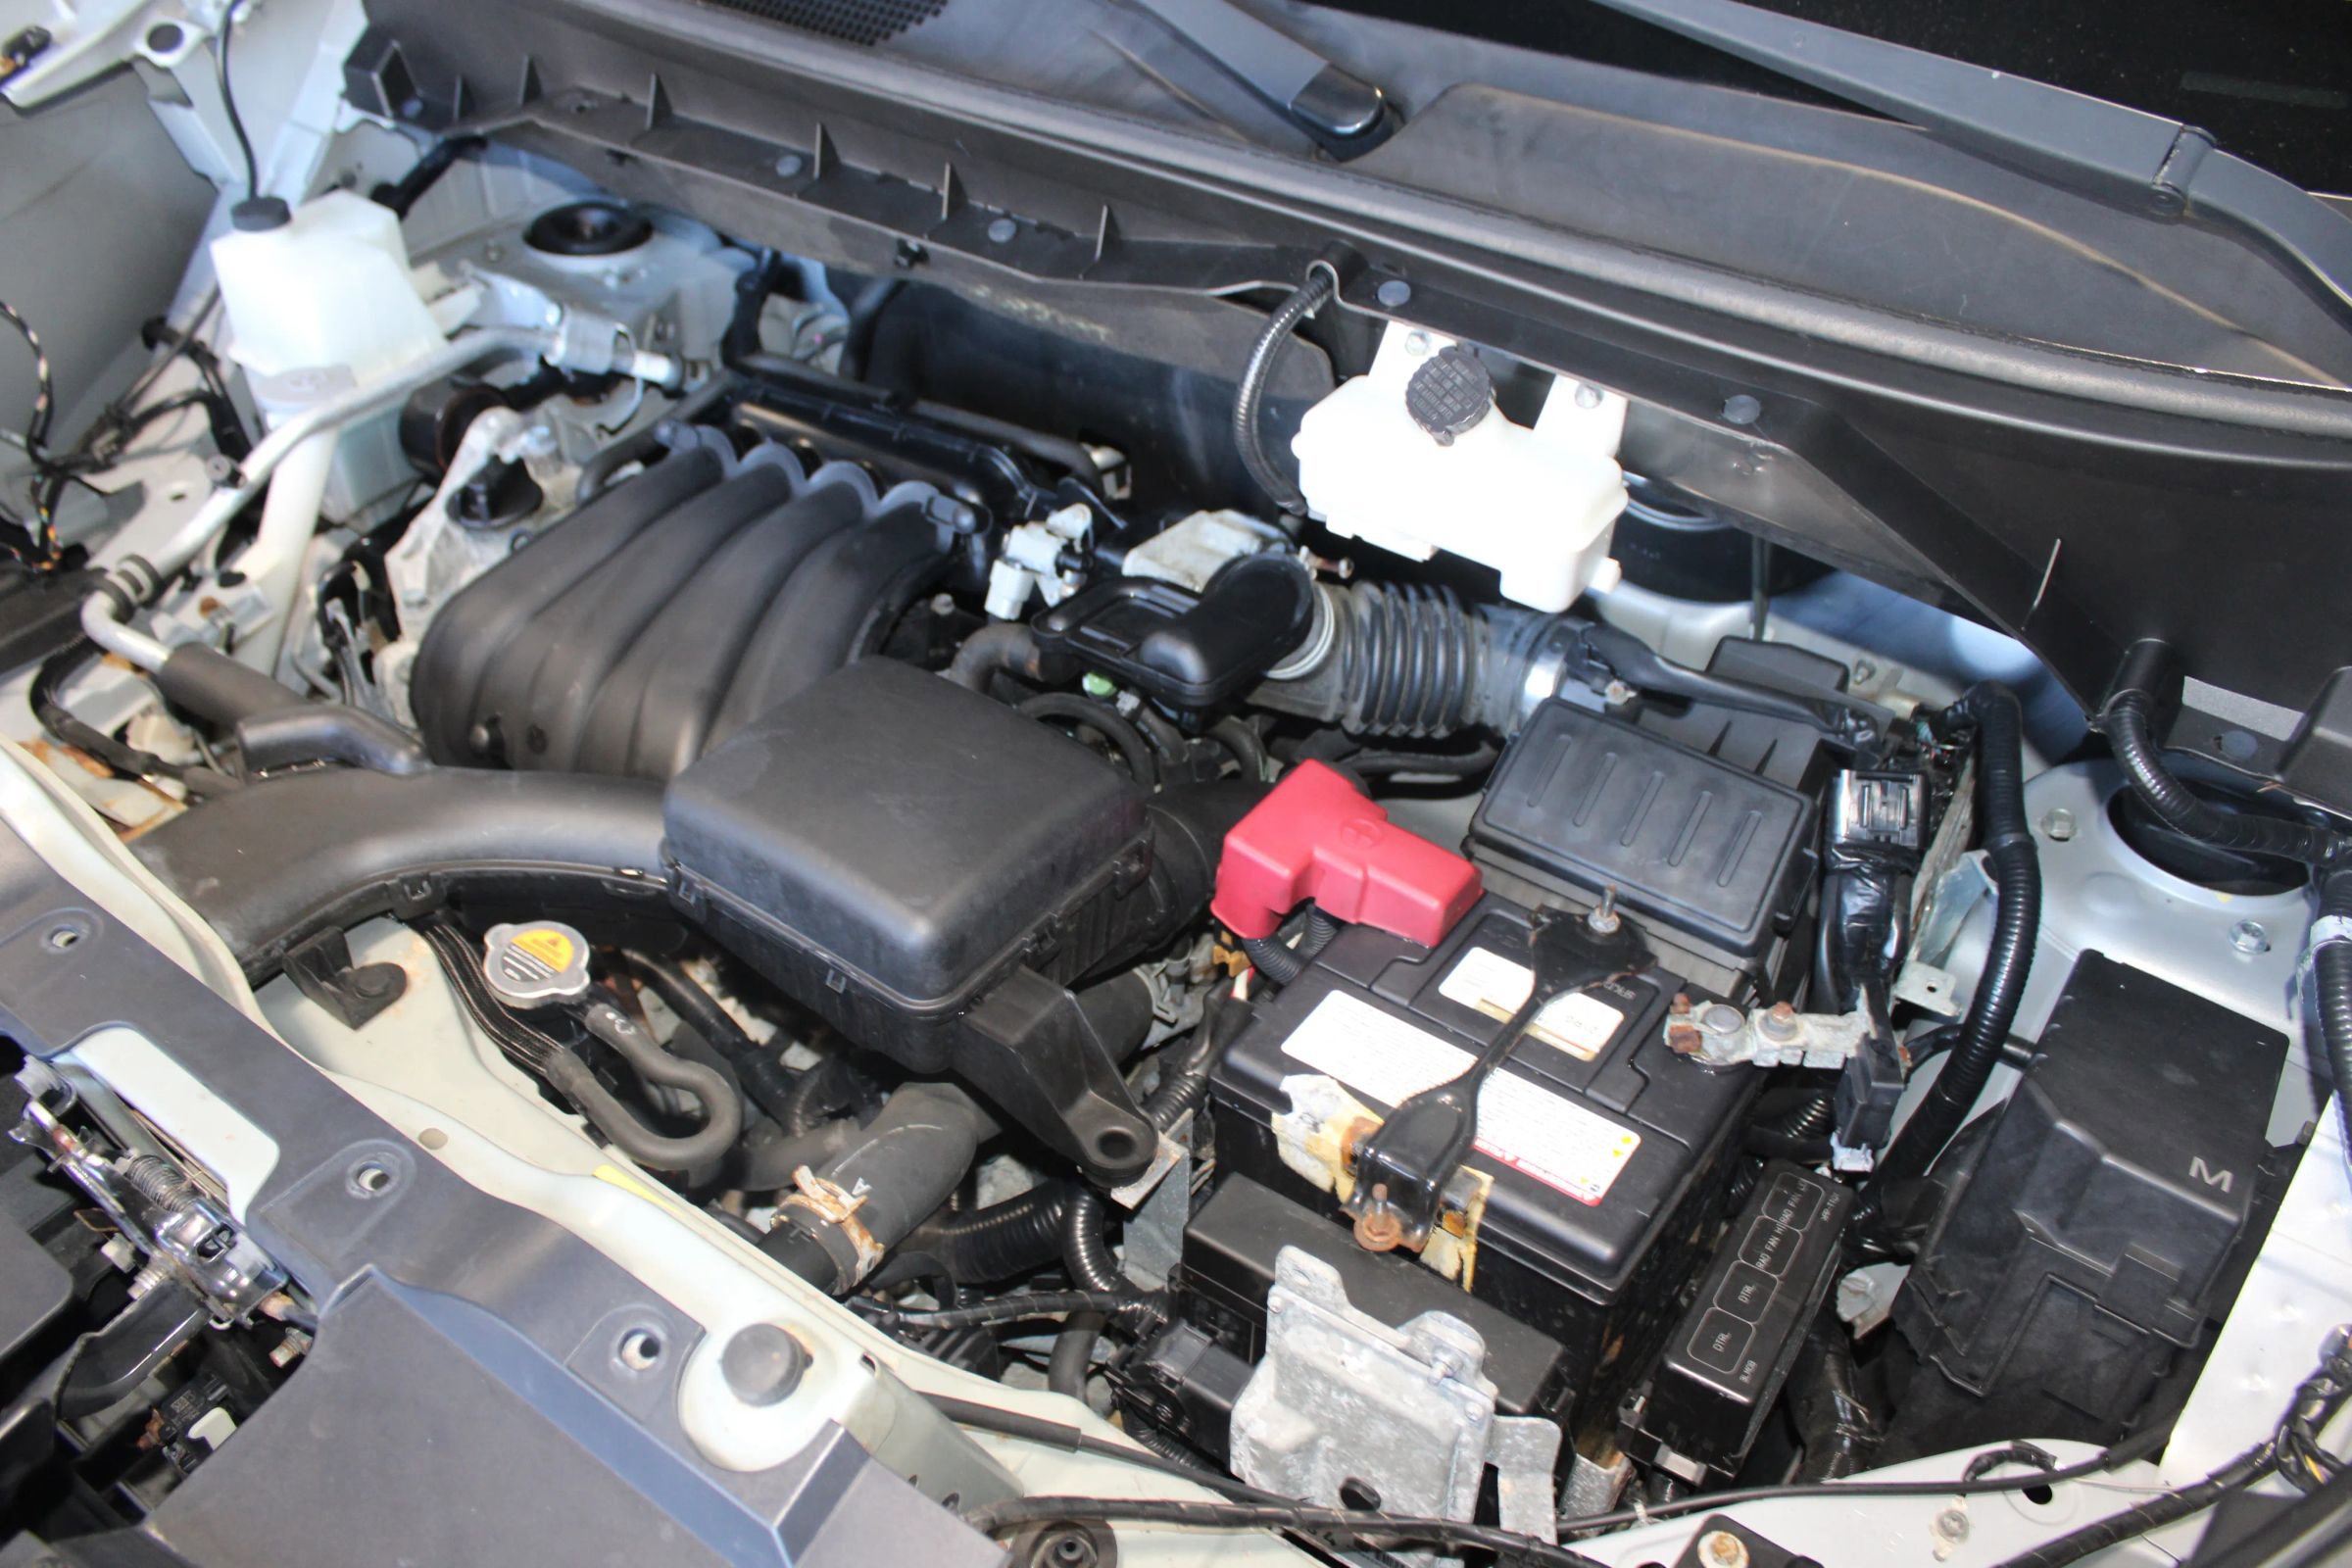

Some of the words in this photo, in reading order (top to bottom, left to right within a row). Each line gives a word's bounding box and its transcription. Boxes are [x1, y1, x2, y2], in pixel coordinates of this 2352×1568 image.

[2188, 1156, 2233, 1193] M
[1779, 1208, 1794, 1224] RAD
[1787, 1192, 1803, 1208] FAN
[1755, 1252, 1772, 1271] RAD
[1764, 1235, 1781, 1253] FAN
[1738, 1284, 1757, 1305] DTRL
[1712, 1332, 1733, 1353] DTRL
